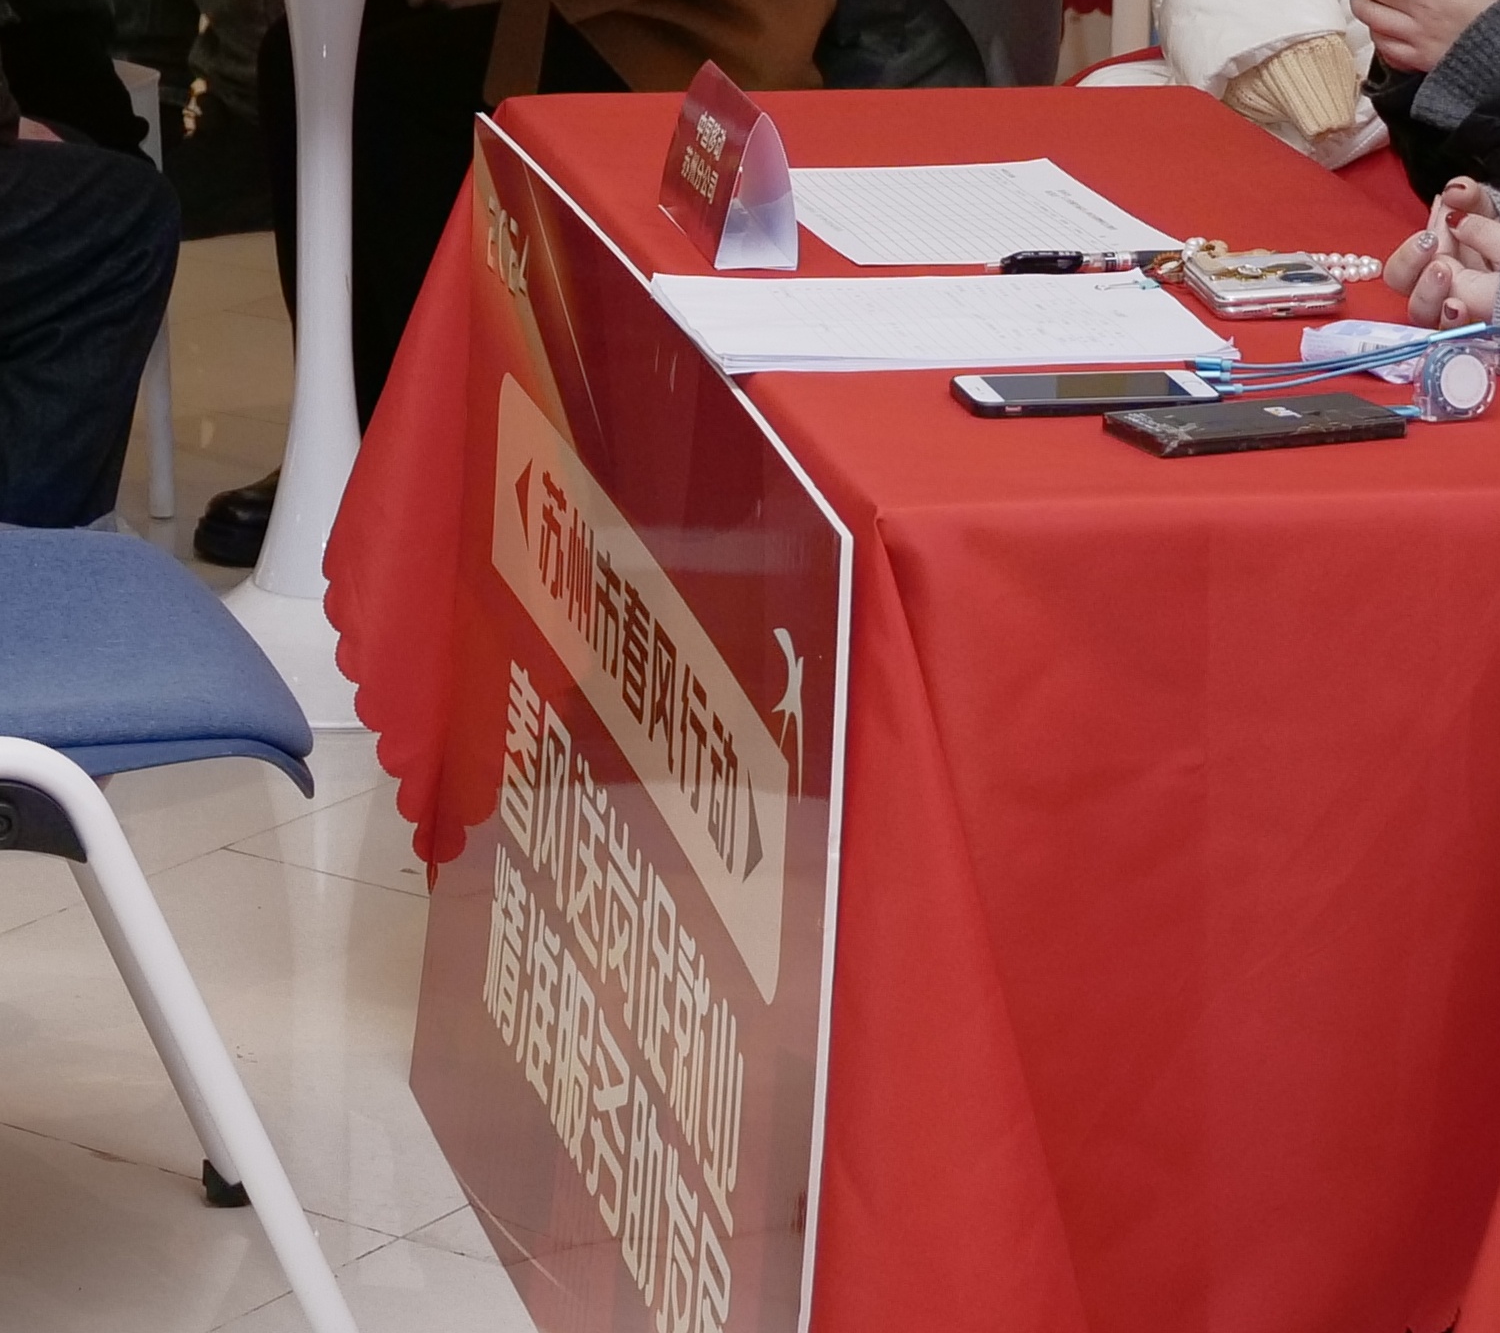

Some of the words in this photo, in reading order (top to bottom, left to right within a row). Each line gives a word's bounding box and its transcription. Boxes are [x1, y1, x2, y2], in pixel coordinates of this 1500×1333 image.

[680, 144, 720, 206] 苏州分公司
[538, 468, 740, 879] 苏州市春风行动
[499, 657, 746, 1239] 春风送岗促就业
